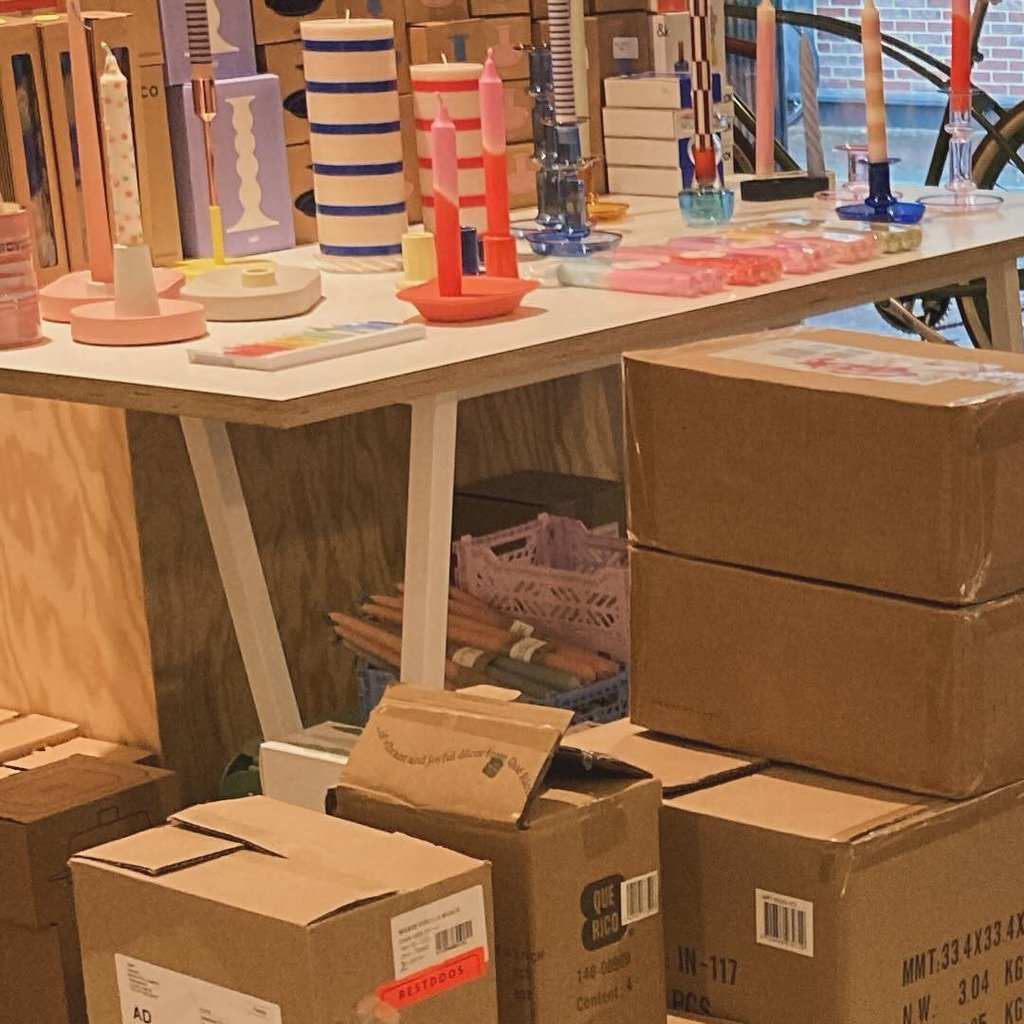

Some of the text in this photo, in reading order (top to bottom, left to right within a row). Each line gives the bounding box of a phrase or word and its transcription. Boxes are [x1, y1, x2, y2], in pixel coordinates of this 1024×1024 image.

[592, 884, 616, 915] QUE
[592, 911, 619, 941] RICO
[678, 946, 738, 986] IN-117
[133, 1006, 152, 1024] AD
